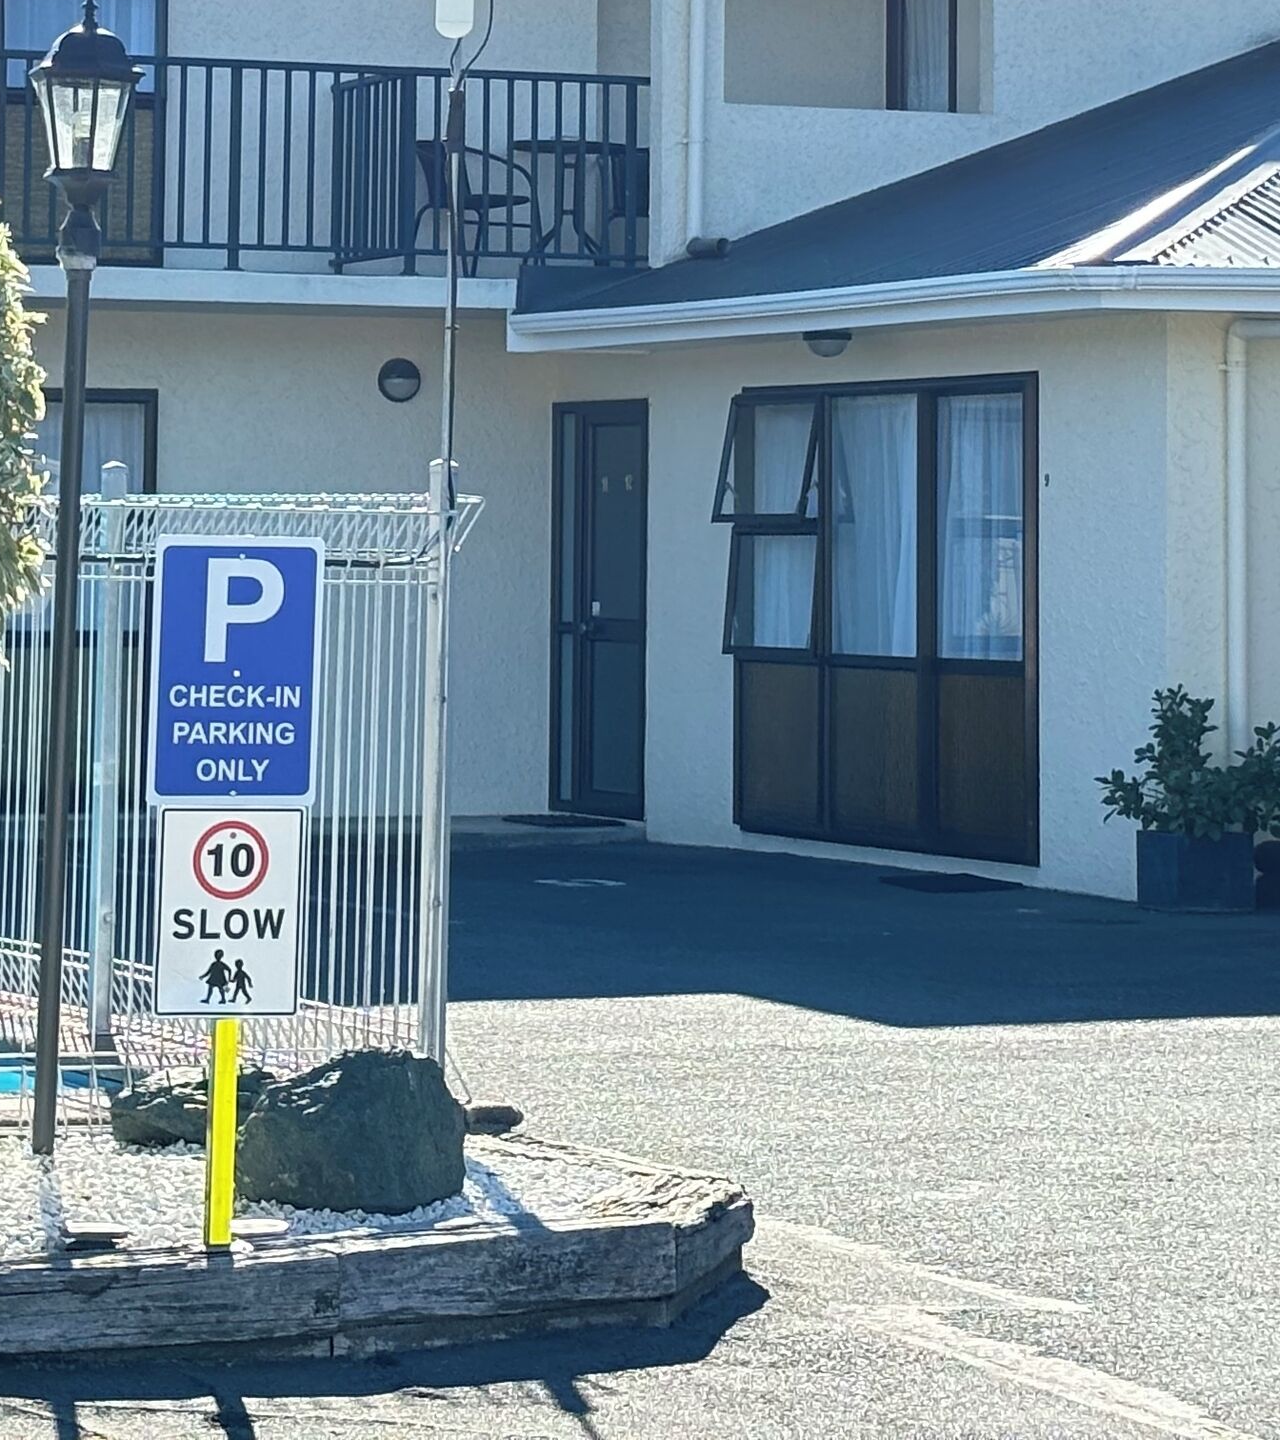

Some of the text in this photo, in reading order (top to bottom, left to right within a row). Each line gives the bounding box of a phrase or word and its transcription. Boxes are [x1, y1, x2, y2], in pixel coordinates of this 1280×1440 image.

[204, 557, 285, 663] P
[169, 684, 301, 709] CHECK-IN
[172, 721, 296, 745] PARKING
[196, 758, 270, 782] ONLY
[207, 843, 256, 878] 10
[172, 908, 286, 940] SLOW
